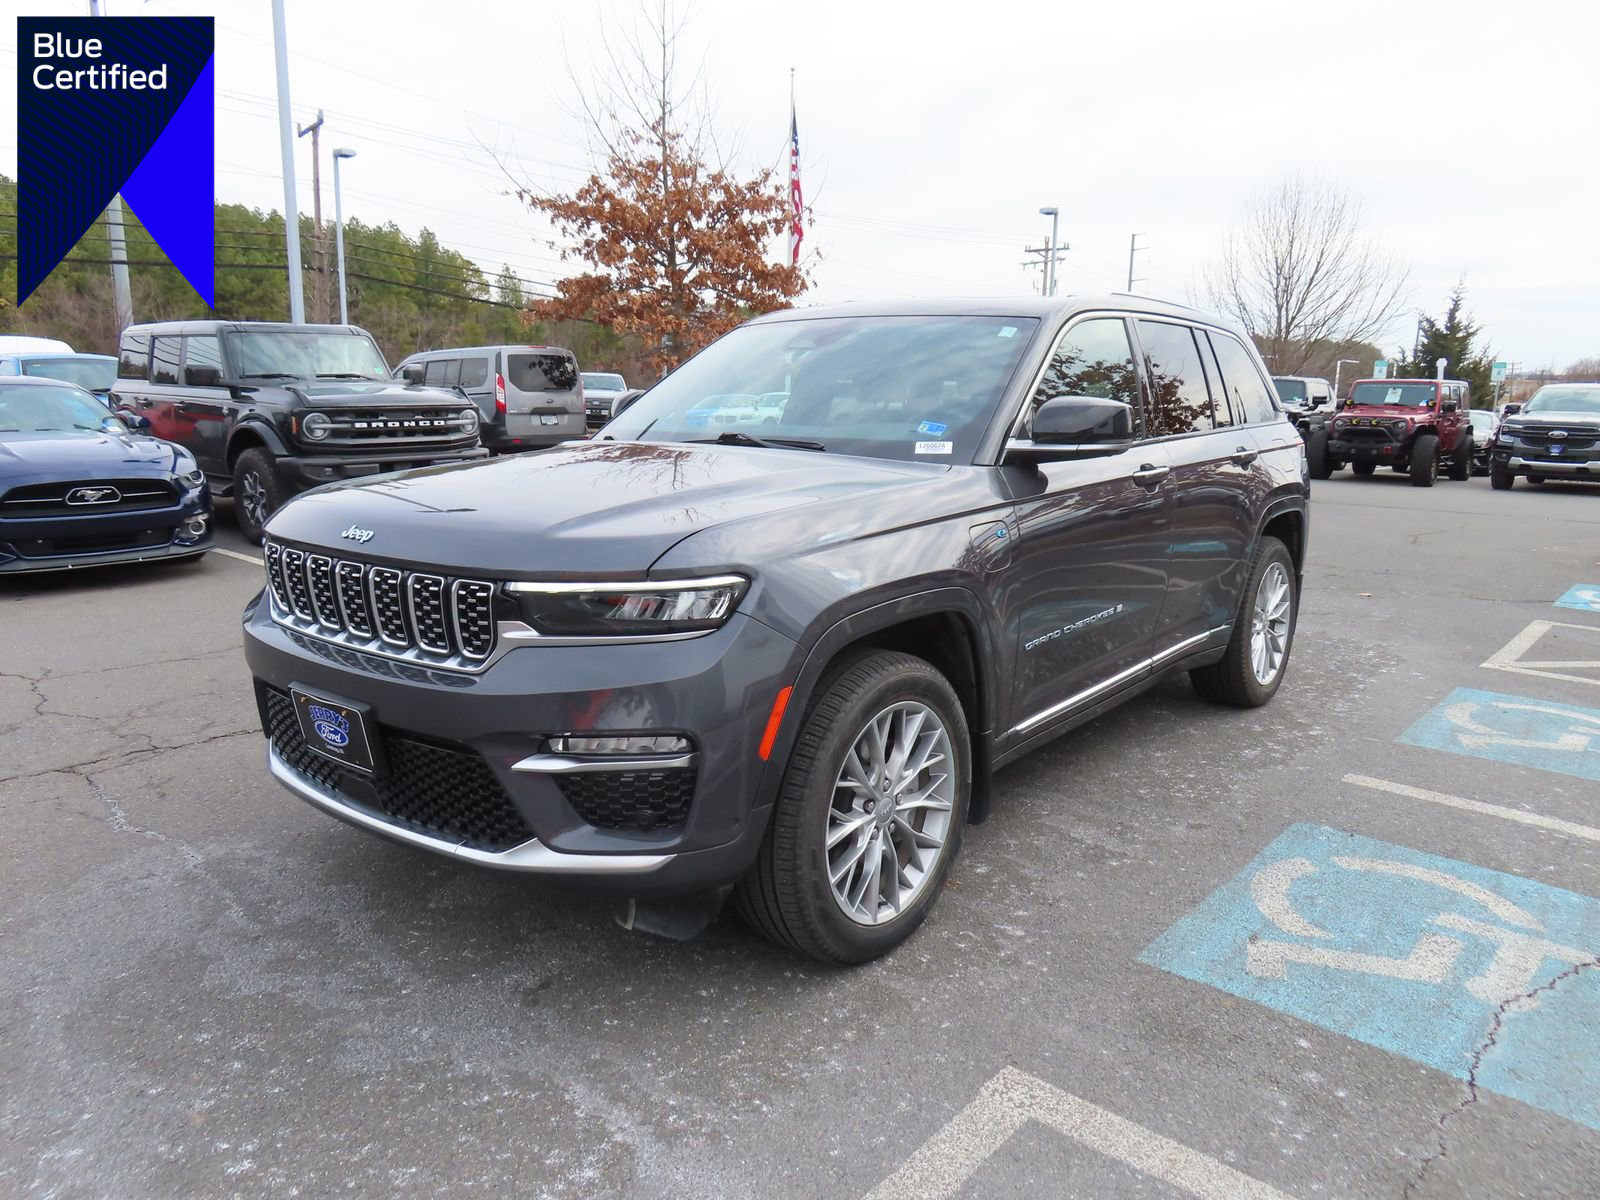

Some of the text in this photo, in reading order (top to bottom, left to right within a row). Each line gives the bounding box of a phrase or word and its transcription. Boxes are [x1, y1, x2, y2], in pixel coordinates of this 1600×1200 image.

[354, 420, 446, 429] BRONCO
[341, 524, 375, 544] Jeep
[1024, 629, 1062, 651] GRAND
[1063, 607, 1115, 634] CHEROKEE
[308, 705, 350, 732] JERRY'S
[320, 724, 343, 743] Ford
